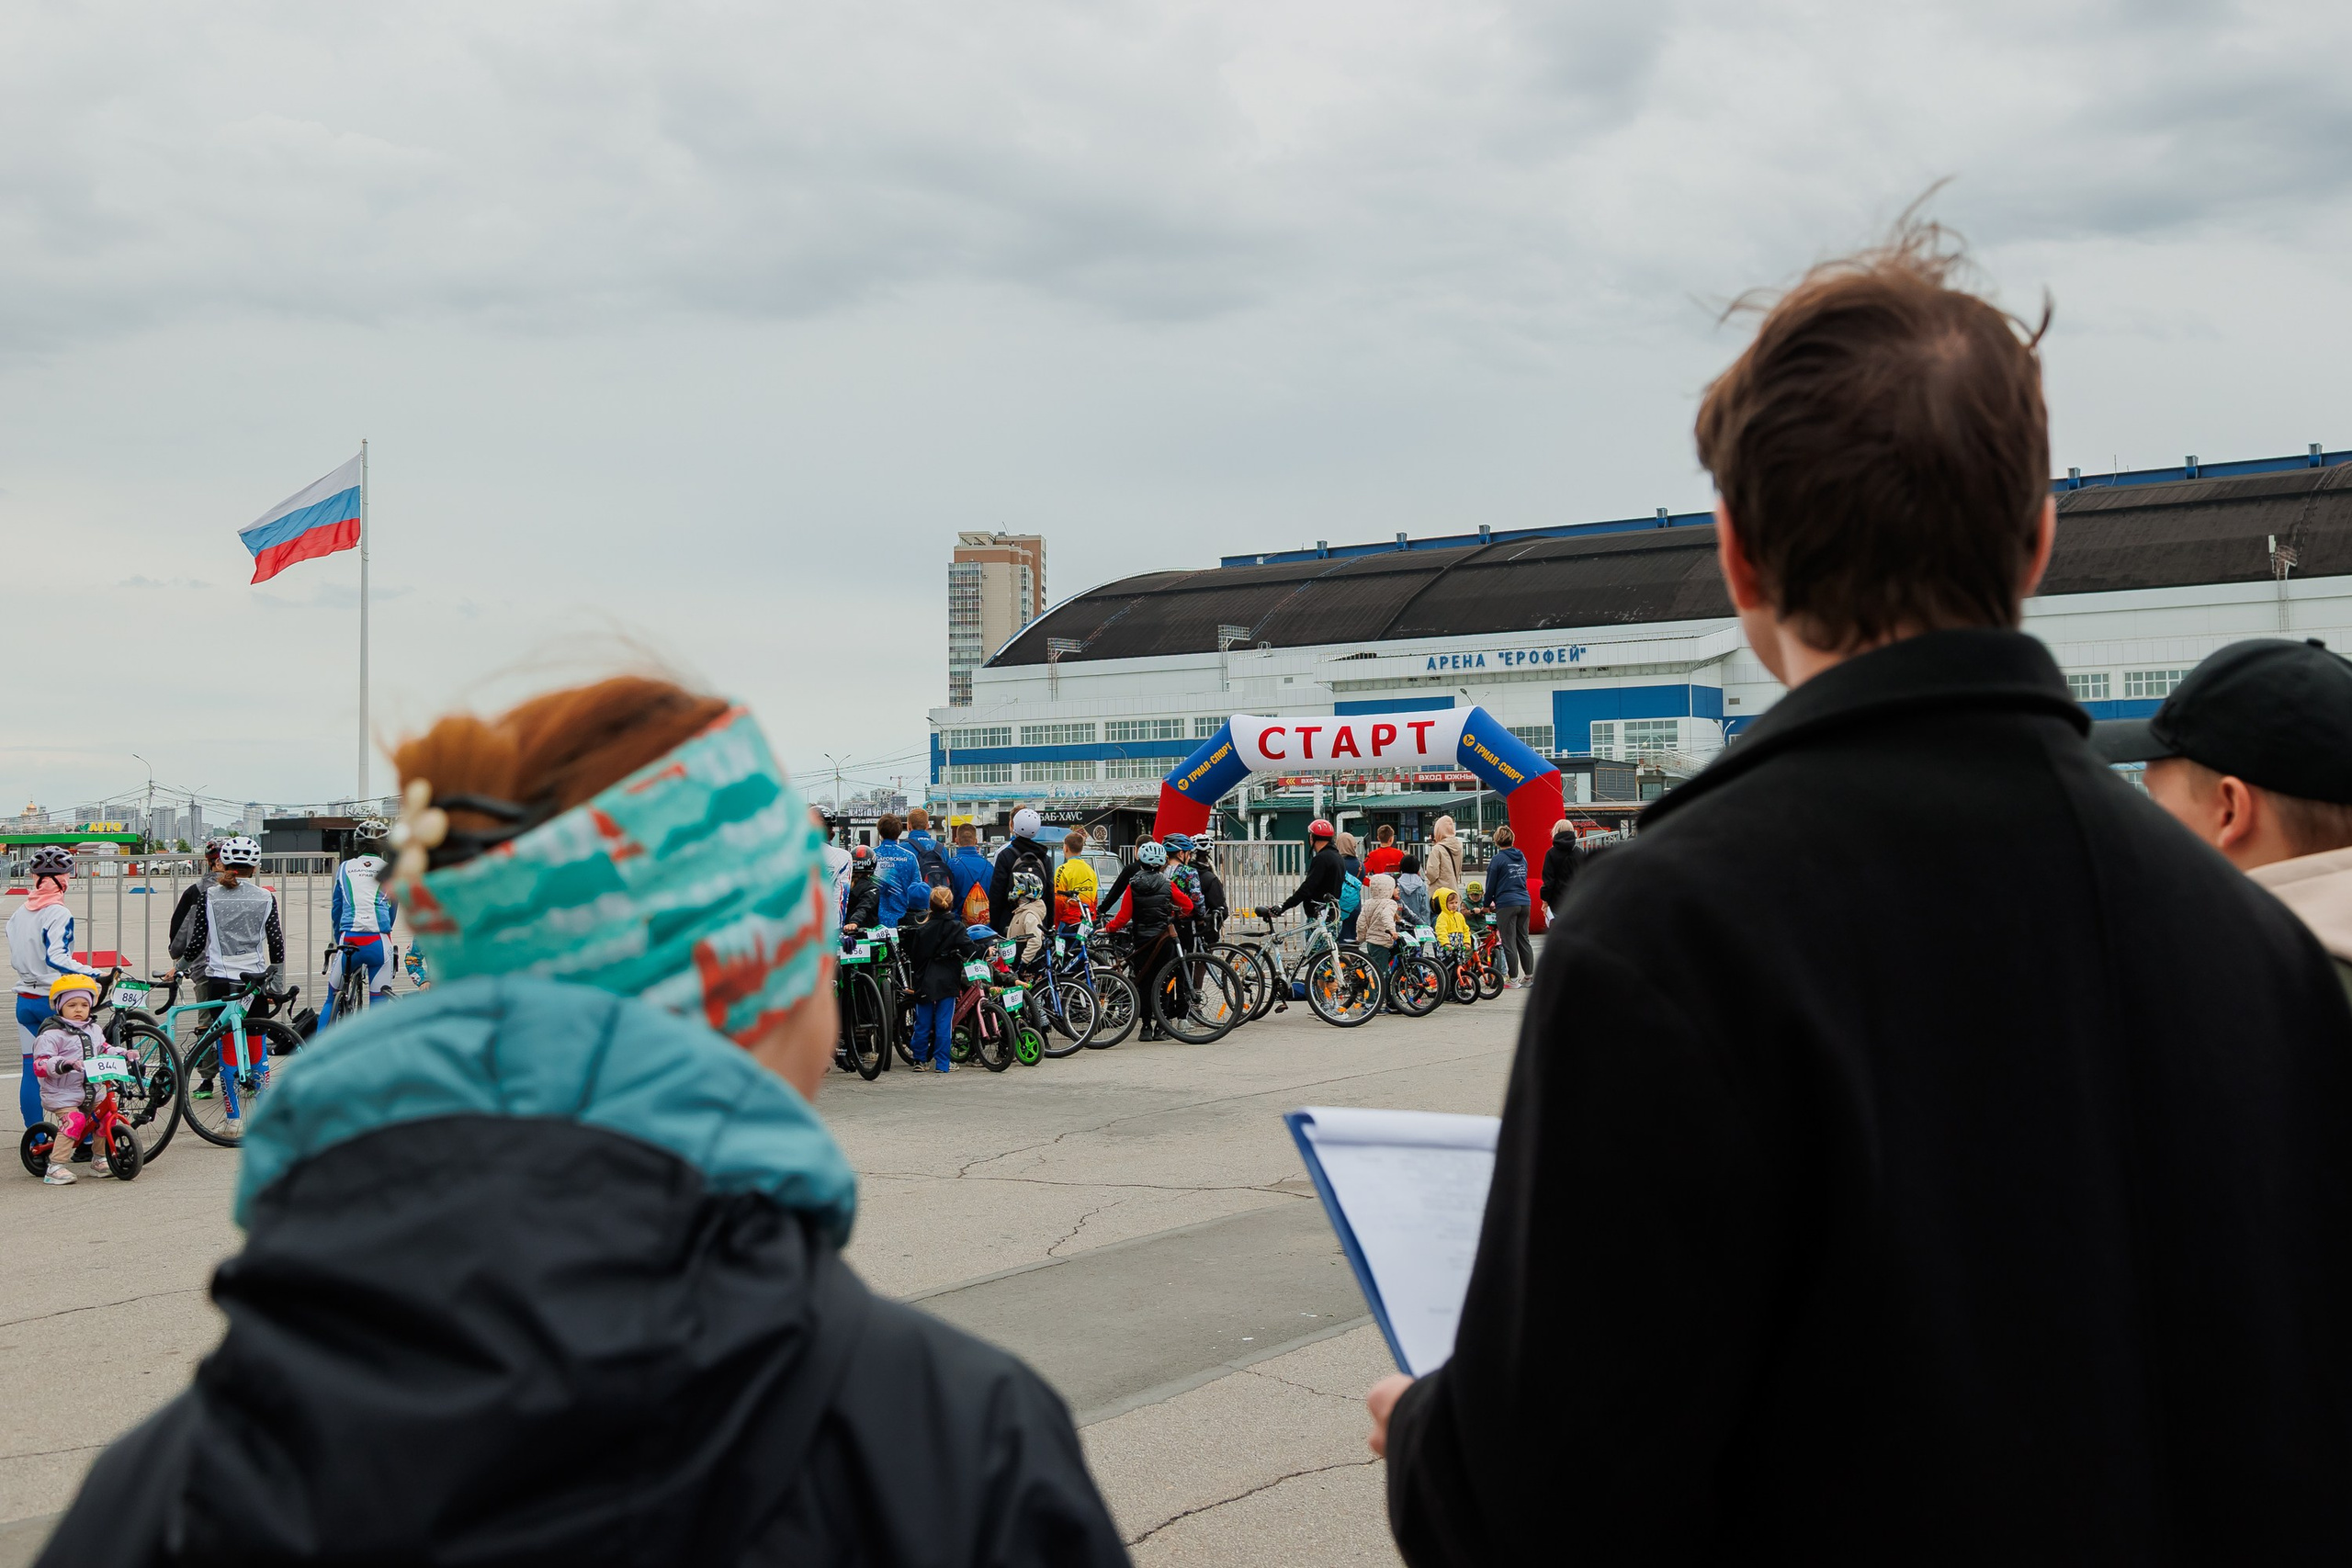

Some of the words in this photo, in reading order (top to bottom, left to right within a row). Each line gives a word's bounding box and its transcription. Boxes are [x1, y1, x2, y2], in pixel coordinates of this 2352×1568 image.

[1427, 653, 1486, 671] АРЕНА
[1498, 644, 1587, 666] "ЕРОФЕЙ"
[1258, 720, 1435, 760] СТАРТ
[1039, 811, 1083, 822] БАБ-ХАУС
[89, 822, 122, 832] ЛЕТО
[1056, 865, 1065, 888] KENDA
[122, 993, 137, 1004] 884
[97, 1061, 117, 1071] 844
